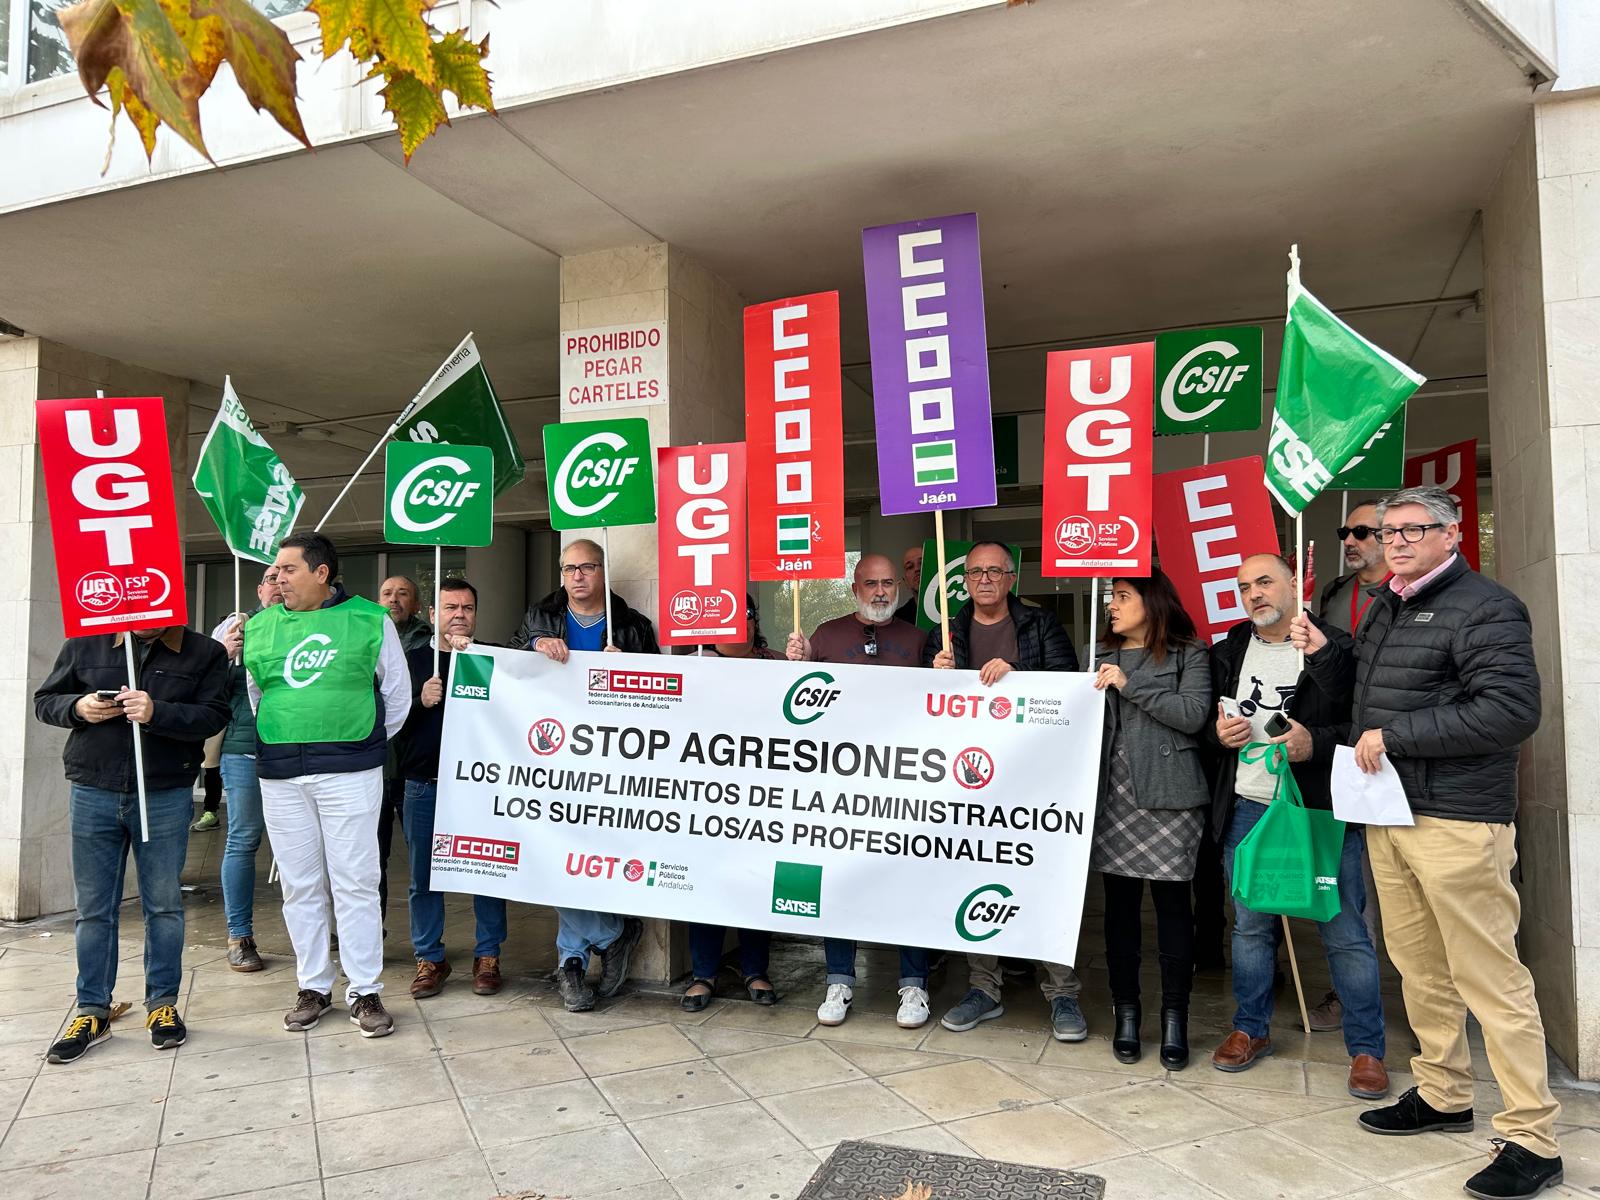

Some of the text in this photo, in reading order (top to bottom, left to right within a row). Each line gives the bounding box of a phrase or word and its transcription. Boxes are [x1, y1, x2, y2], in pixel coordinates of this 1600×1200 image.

[567, 328, 661, 356] PROHIBIDO
[898, 229, 955, 435] CCOO
[584, 356, 643, 379] PEGAR
[1178, 365, 1251, 394] CSIF
[568, 379, 660, 405] CARTELES
[773, 304, 812, 504] CCOO
[1065, 355, 1132, 511] UGT
[571, 456, 640, 489] CSIF
[65, 408, 153, 567] UGT
[409, 479, 481, 508] CSIF
[918, 489, 957, 505] Jaén
[675, 453, 730, 587] UGT
[1061, 522, 1090, 538] UGT
[1098, 523, 1122, 535] FSP
[776, 557, 812, 572] Jaén
[1183, 475, 1250, 645] CCO
[82, 577, 116, 596] UGT
[125, 576, 150, 589] FSP
[946, 574, 972, 601] CS
[674, 596, 698, 611] UGT
[704, 596, 723, 607] FSP
[293, 649, 339, 670] CSIF
[455, 685, 487, 698] SATSE
[613, 674, 665, 690] CCOO
[588, 691, 618, 699] federación
[588, 700, 632, 708] sociosanitarios
[793, 687, 842, 709] CSIF
[1029, 697, 1062, 706] Servicios
[926, 693, 985, 719] UGT
[1028, 706, 1059, 715] Públicos
[1028, 715, 1070, 726] Andalucía
[569, 723, 947, 783] STOP AGRESIONES
[455, 760, 1084, 835] LOS INCUMPLIMIENTOS DE LA ADMINISTRACIÓN
[493, 796, 1034, 867] LOS SUFRIMOS LOS/AS PROFESIONALES
[457, 840, 505, 858] CCOO
[471, 860, 491, 868] sanidad
[565, 853, 620, 879] UGT
[660, 863, 689, 872] Servicios
[658, 880, 694, 891] Andalucía
[659, 871, 685, 880] Públicos
[775, 898, 817, 915] SATSE
[967, 901, 1020, 924] CSIF
